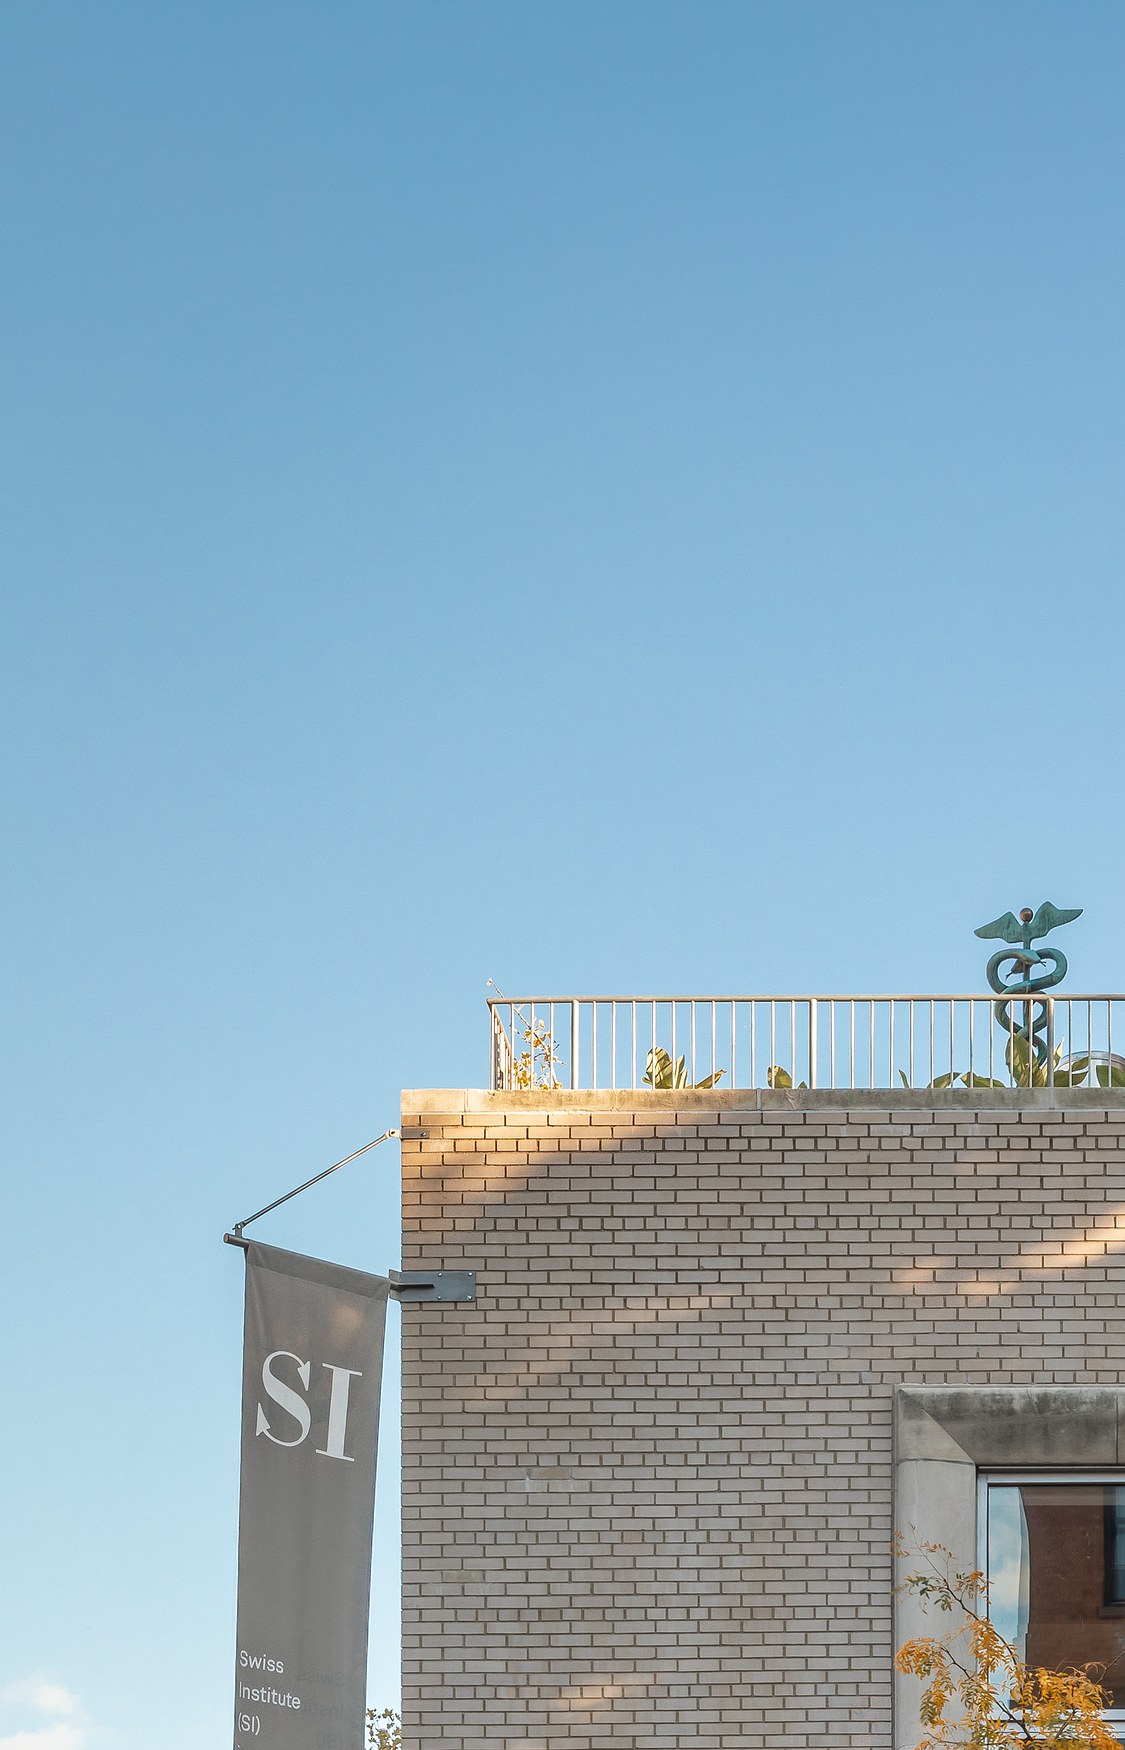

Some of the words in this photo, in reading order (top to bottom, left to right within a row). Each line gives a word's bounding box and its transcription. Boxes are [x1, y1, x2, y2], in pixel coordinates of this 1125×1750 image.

[256, 1350, 363, 1462] SI
[240, 1650, 284, 1674] Swiss
[239, 1682, 301, 1709] Institute
[238, 1712, 261, 1735] (SI)
